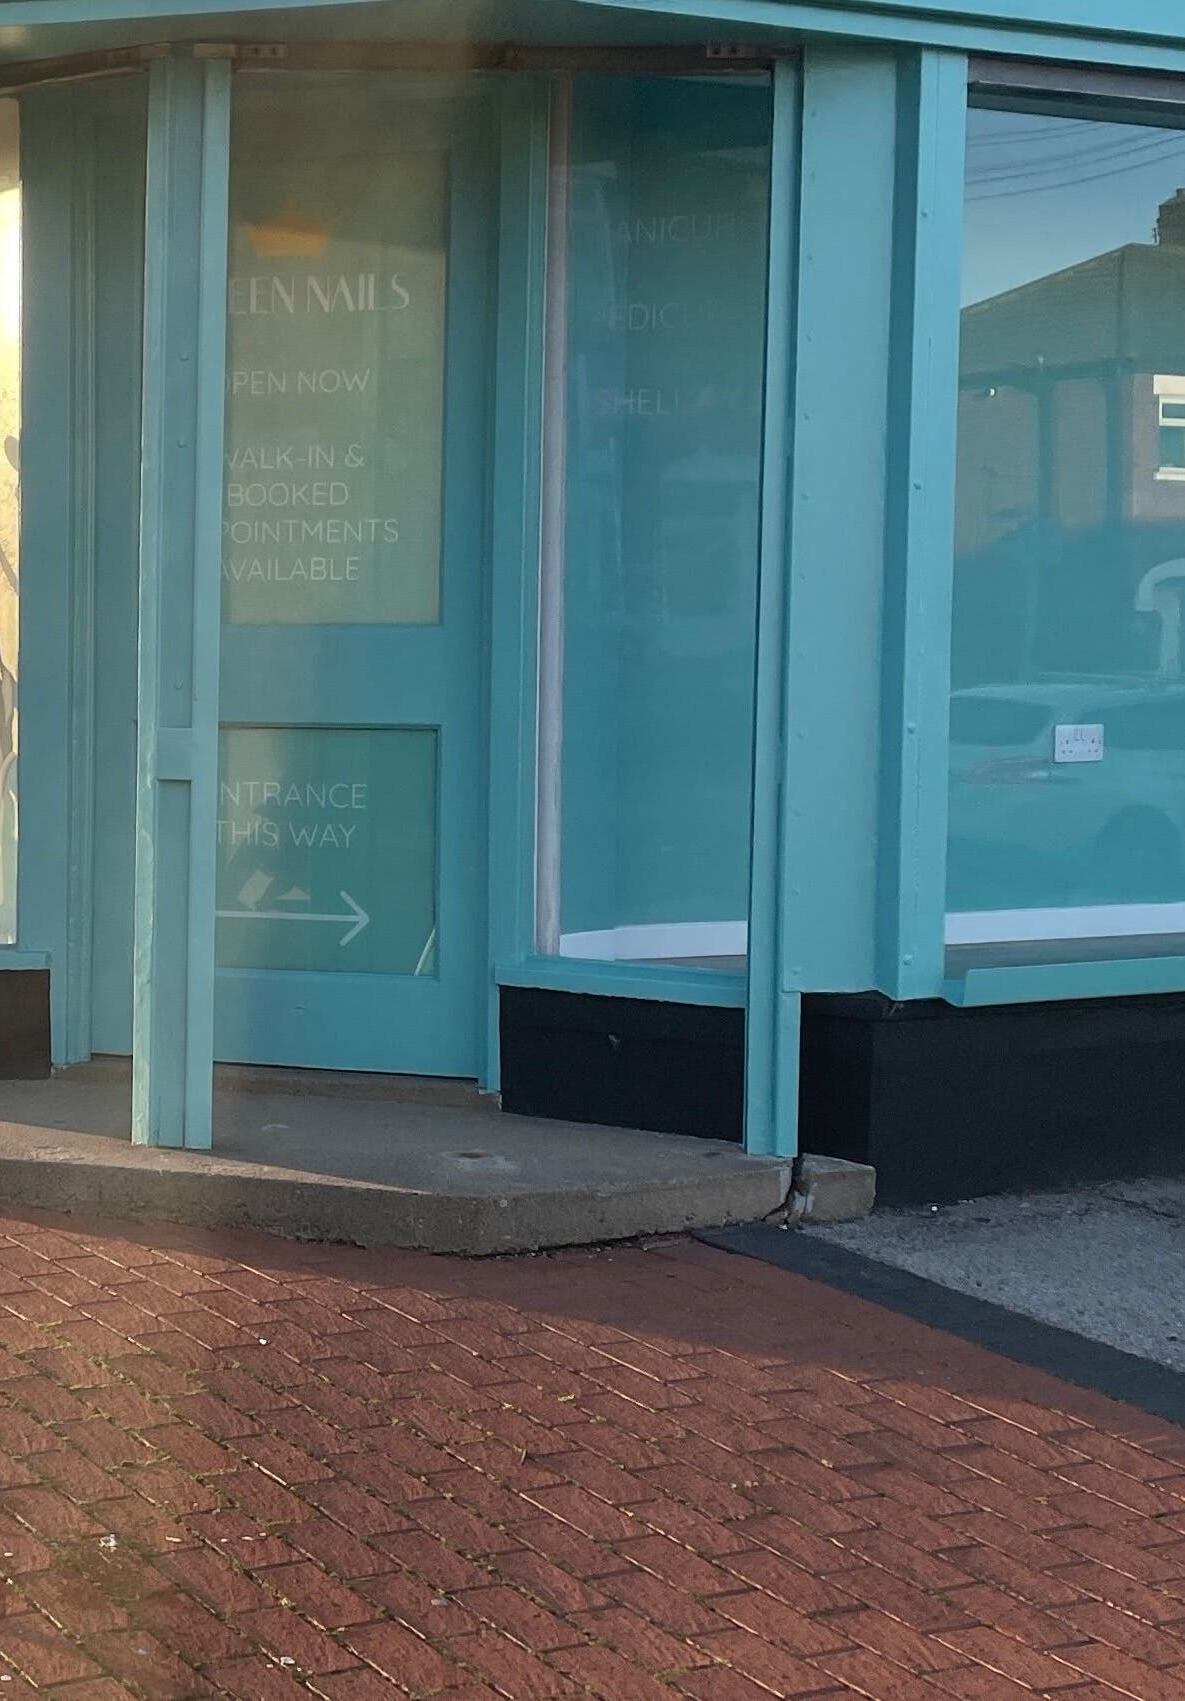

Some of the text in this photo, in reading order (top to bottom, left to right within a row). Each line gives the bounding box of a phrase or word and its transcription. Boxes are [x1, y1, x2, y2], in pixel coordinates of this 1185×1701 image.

[306, 272, 411, 314] NAILS
[226, 368, 371, 395] PEN NOW
[344, 443, 366, 469] &
[227, 482, 350, 507] BOOKED
[219, 781, 368, 809] NTRANCE
[215, 819, 357, 849] THIS WAY
